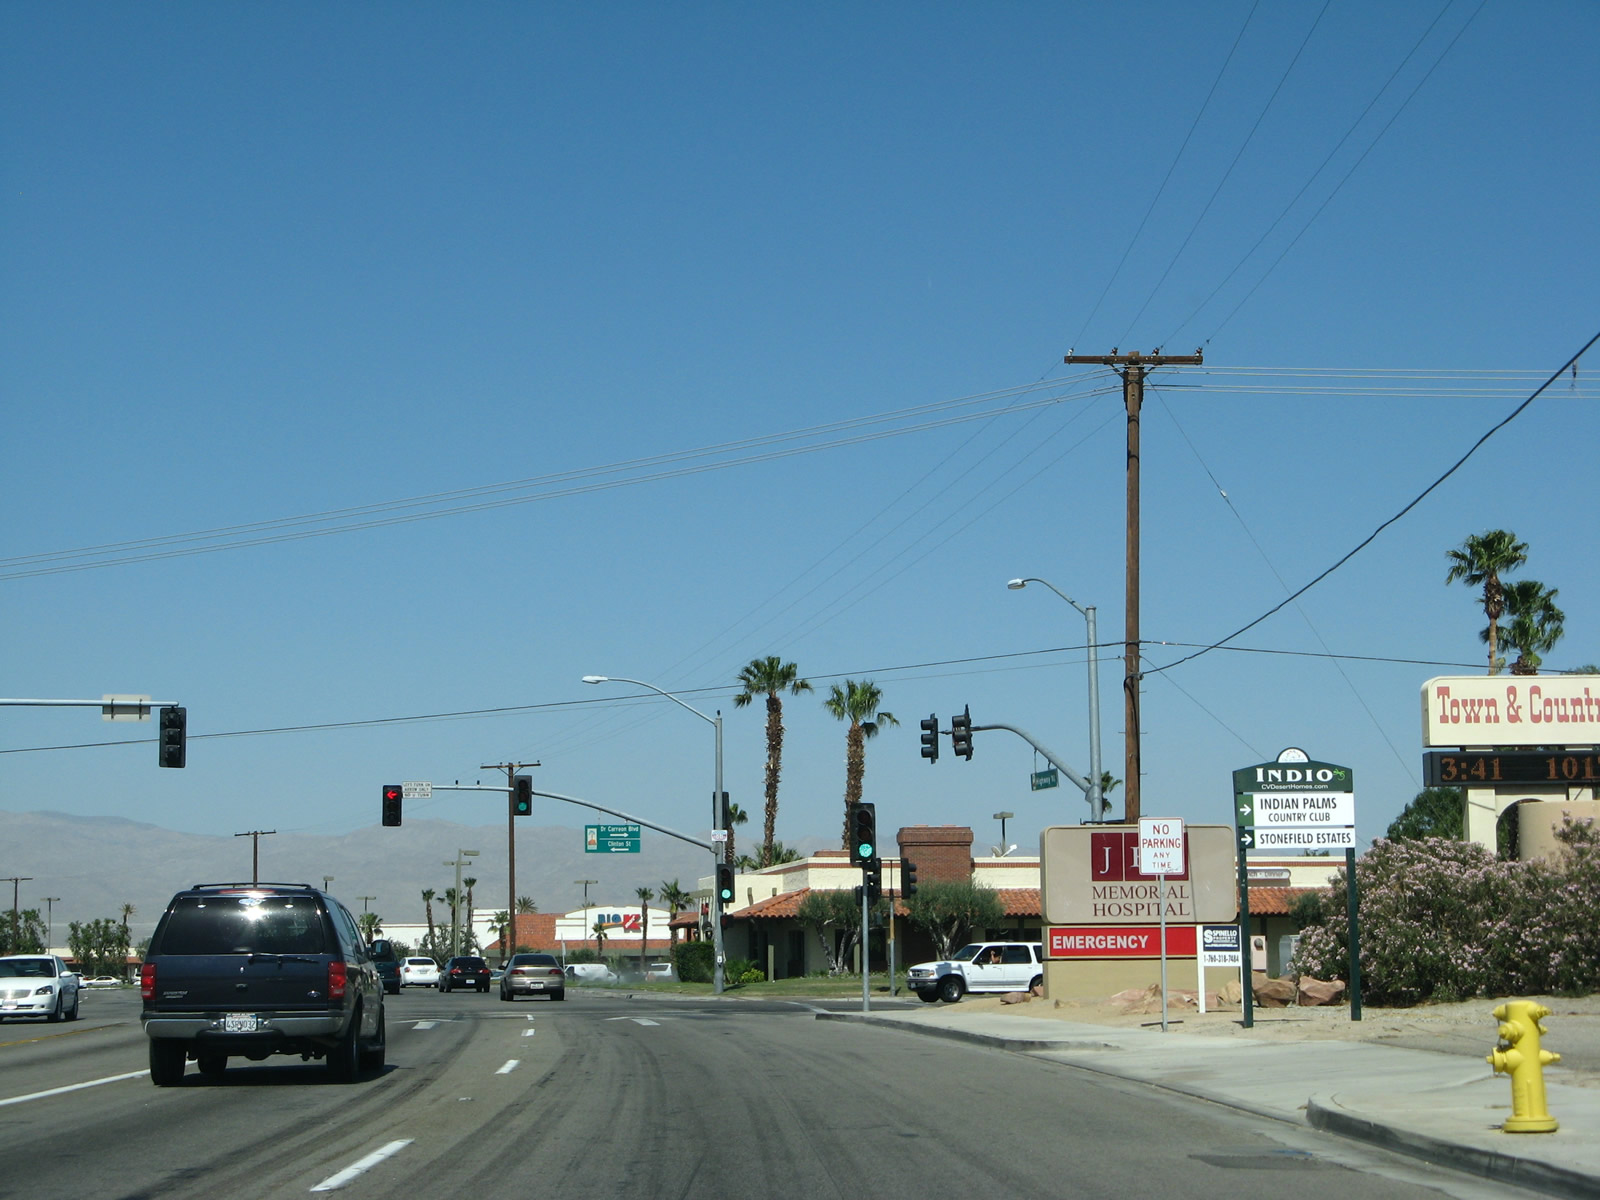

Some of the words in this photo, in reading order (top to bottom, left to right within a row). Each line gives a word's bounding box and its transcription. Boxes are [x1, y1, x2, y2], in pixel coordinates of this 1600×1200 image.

[1437, 686, 1499, 724] Town
[1506, 685, 1522, 724] &
[1441, 757, 1503, 781] 3:41
[1260, 799, 1299, 810] INDIAN
[1303, 798, 1337, 809] PALMS
[1268, 813, 1306, 822] COUNTRY
[1309, 812, 1331, 822] CLUB
[1152, 824, 1169, 834] NO
[1142, 838, 1181, 848] PARKING
[1260, 834, 1313, 844] STONEFIELD
[1317, 833, 1351, 843] ESTATES
[1092, 886, 1190, 899] MEMORAL
[1093, 902, 1190, 917] HOSPITAL
[1052, 935, 1149, 949] EMERGENCY
